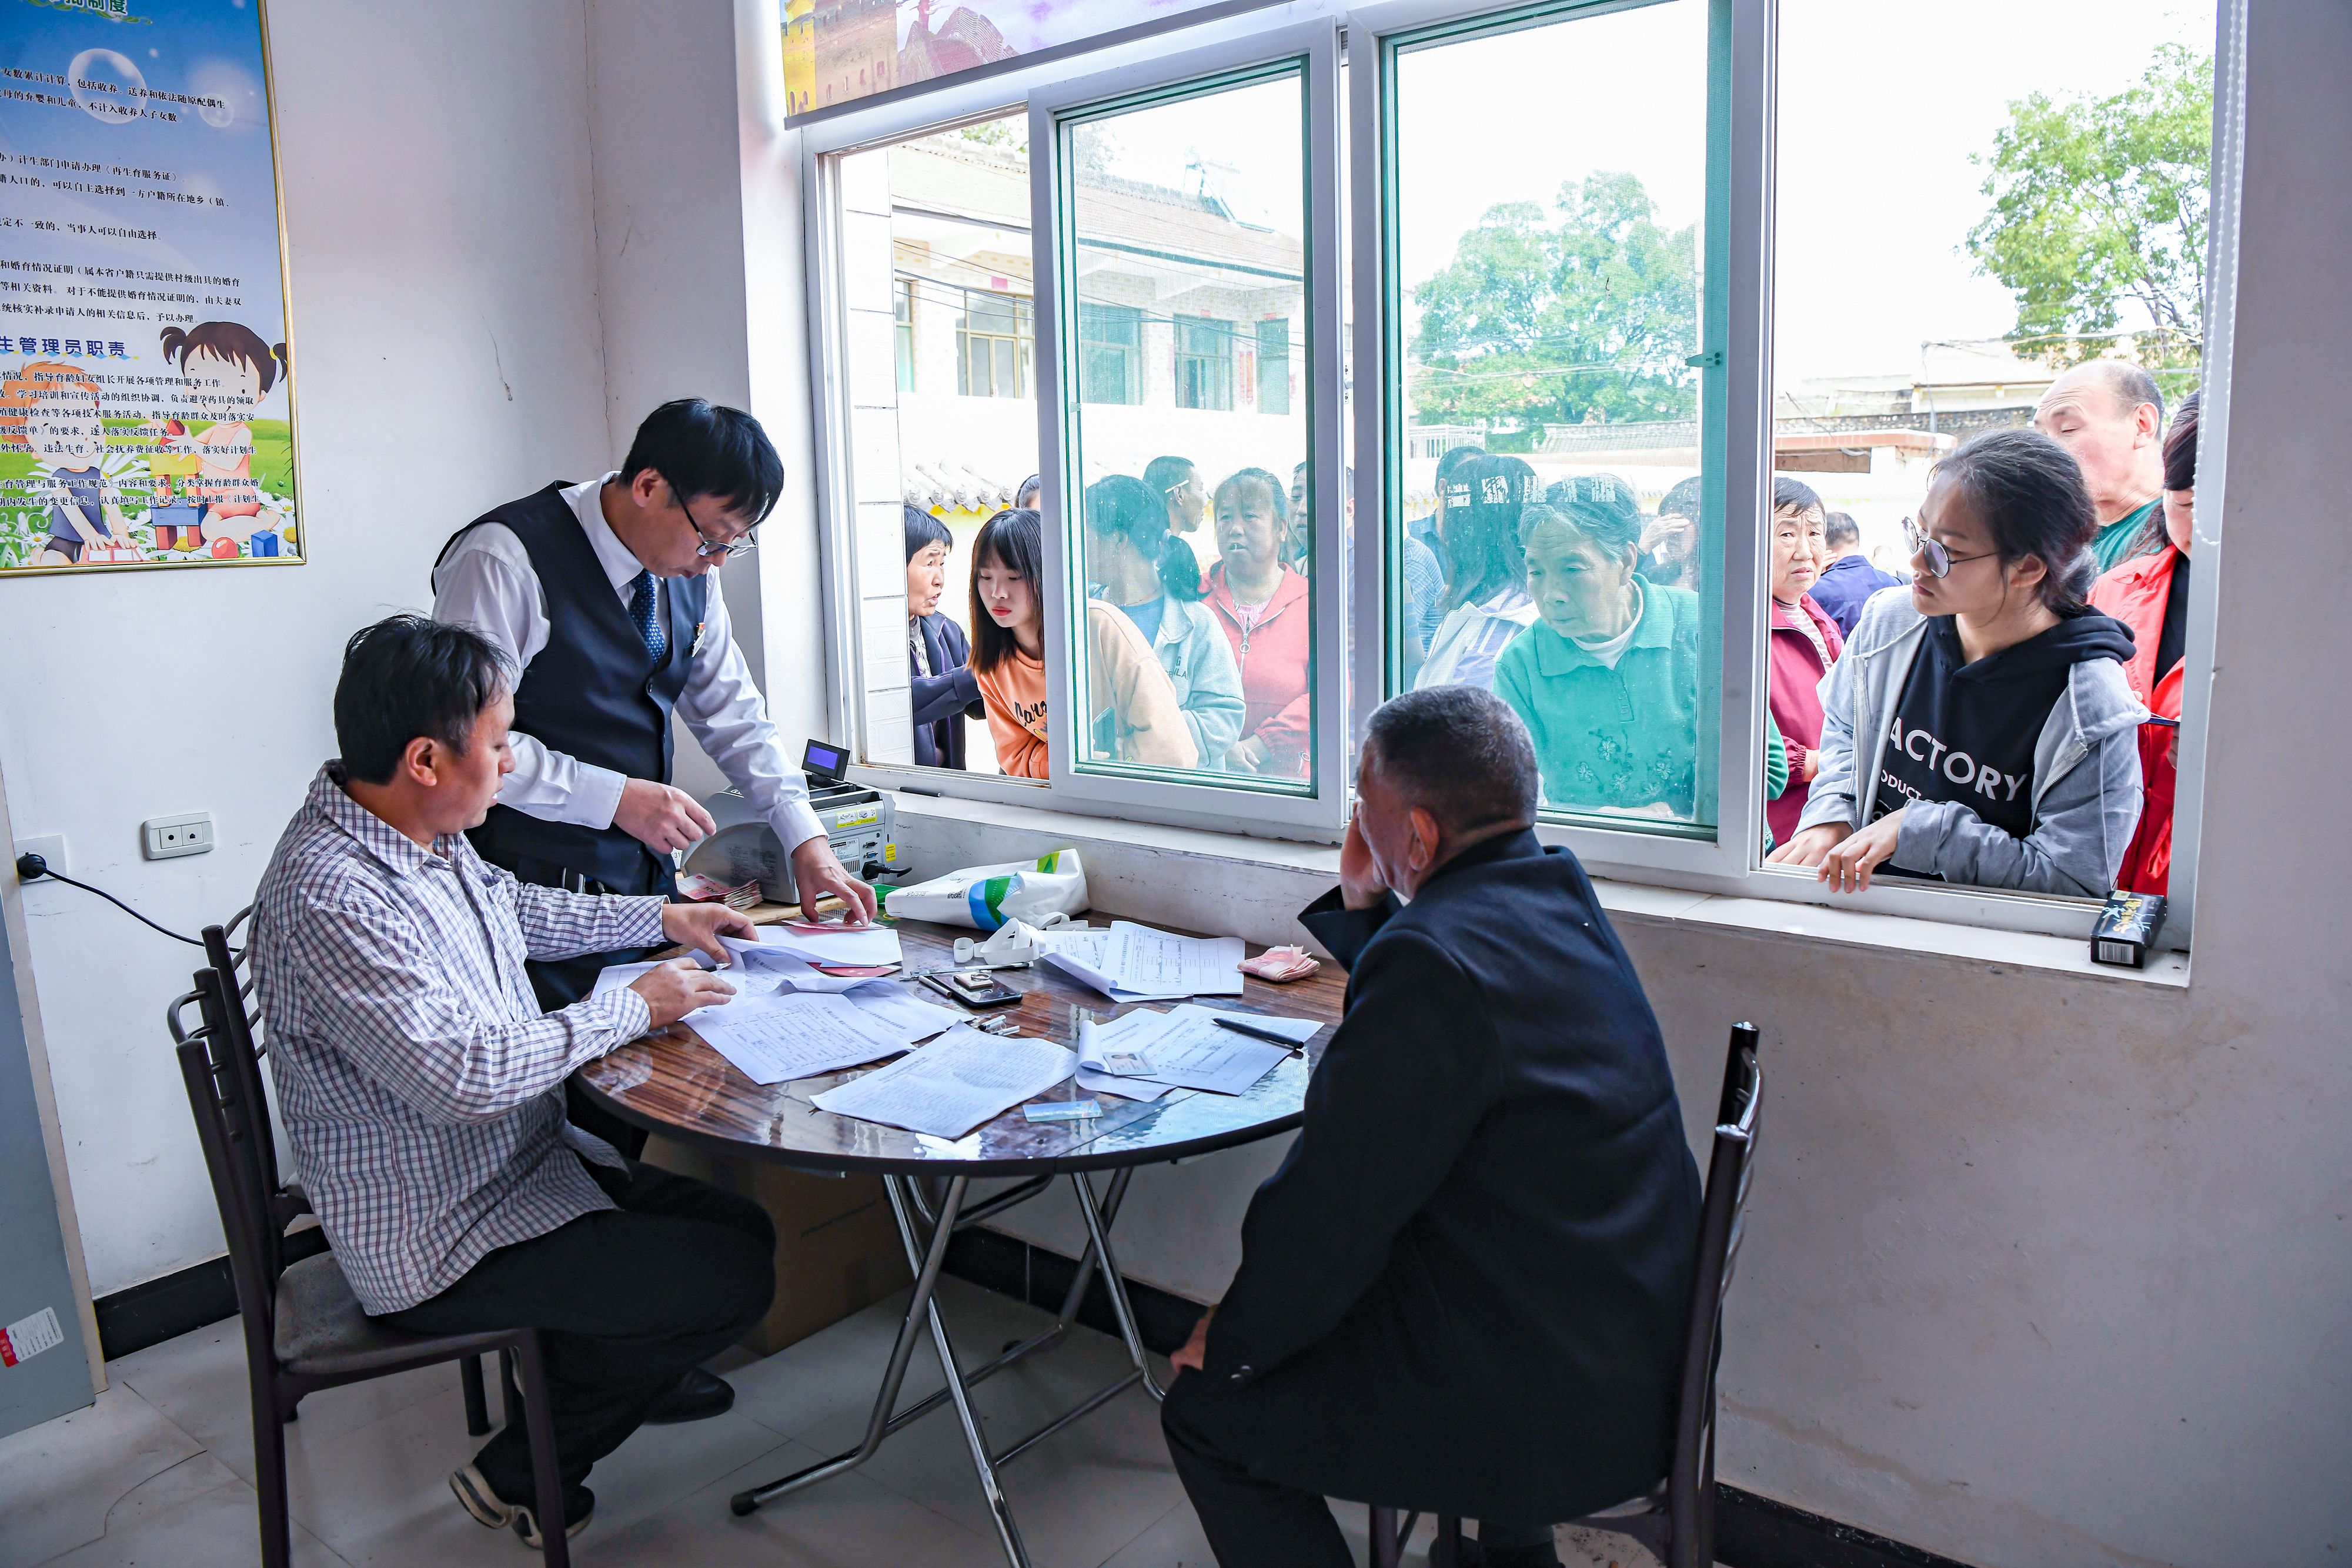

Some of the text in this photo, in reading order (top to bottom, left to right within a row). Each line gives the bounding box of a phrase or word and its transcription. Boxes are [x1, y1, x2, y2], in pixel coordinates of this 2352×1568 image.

[0, 336, 125, 356] 生管理员职责
